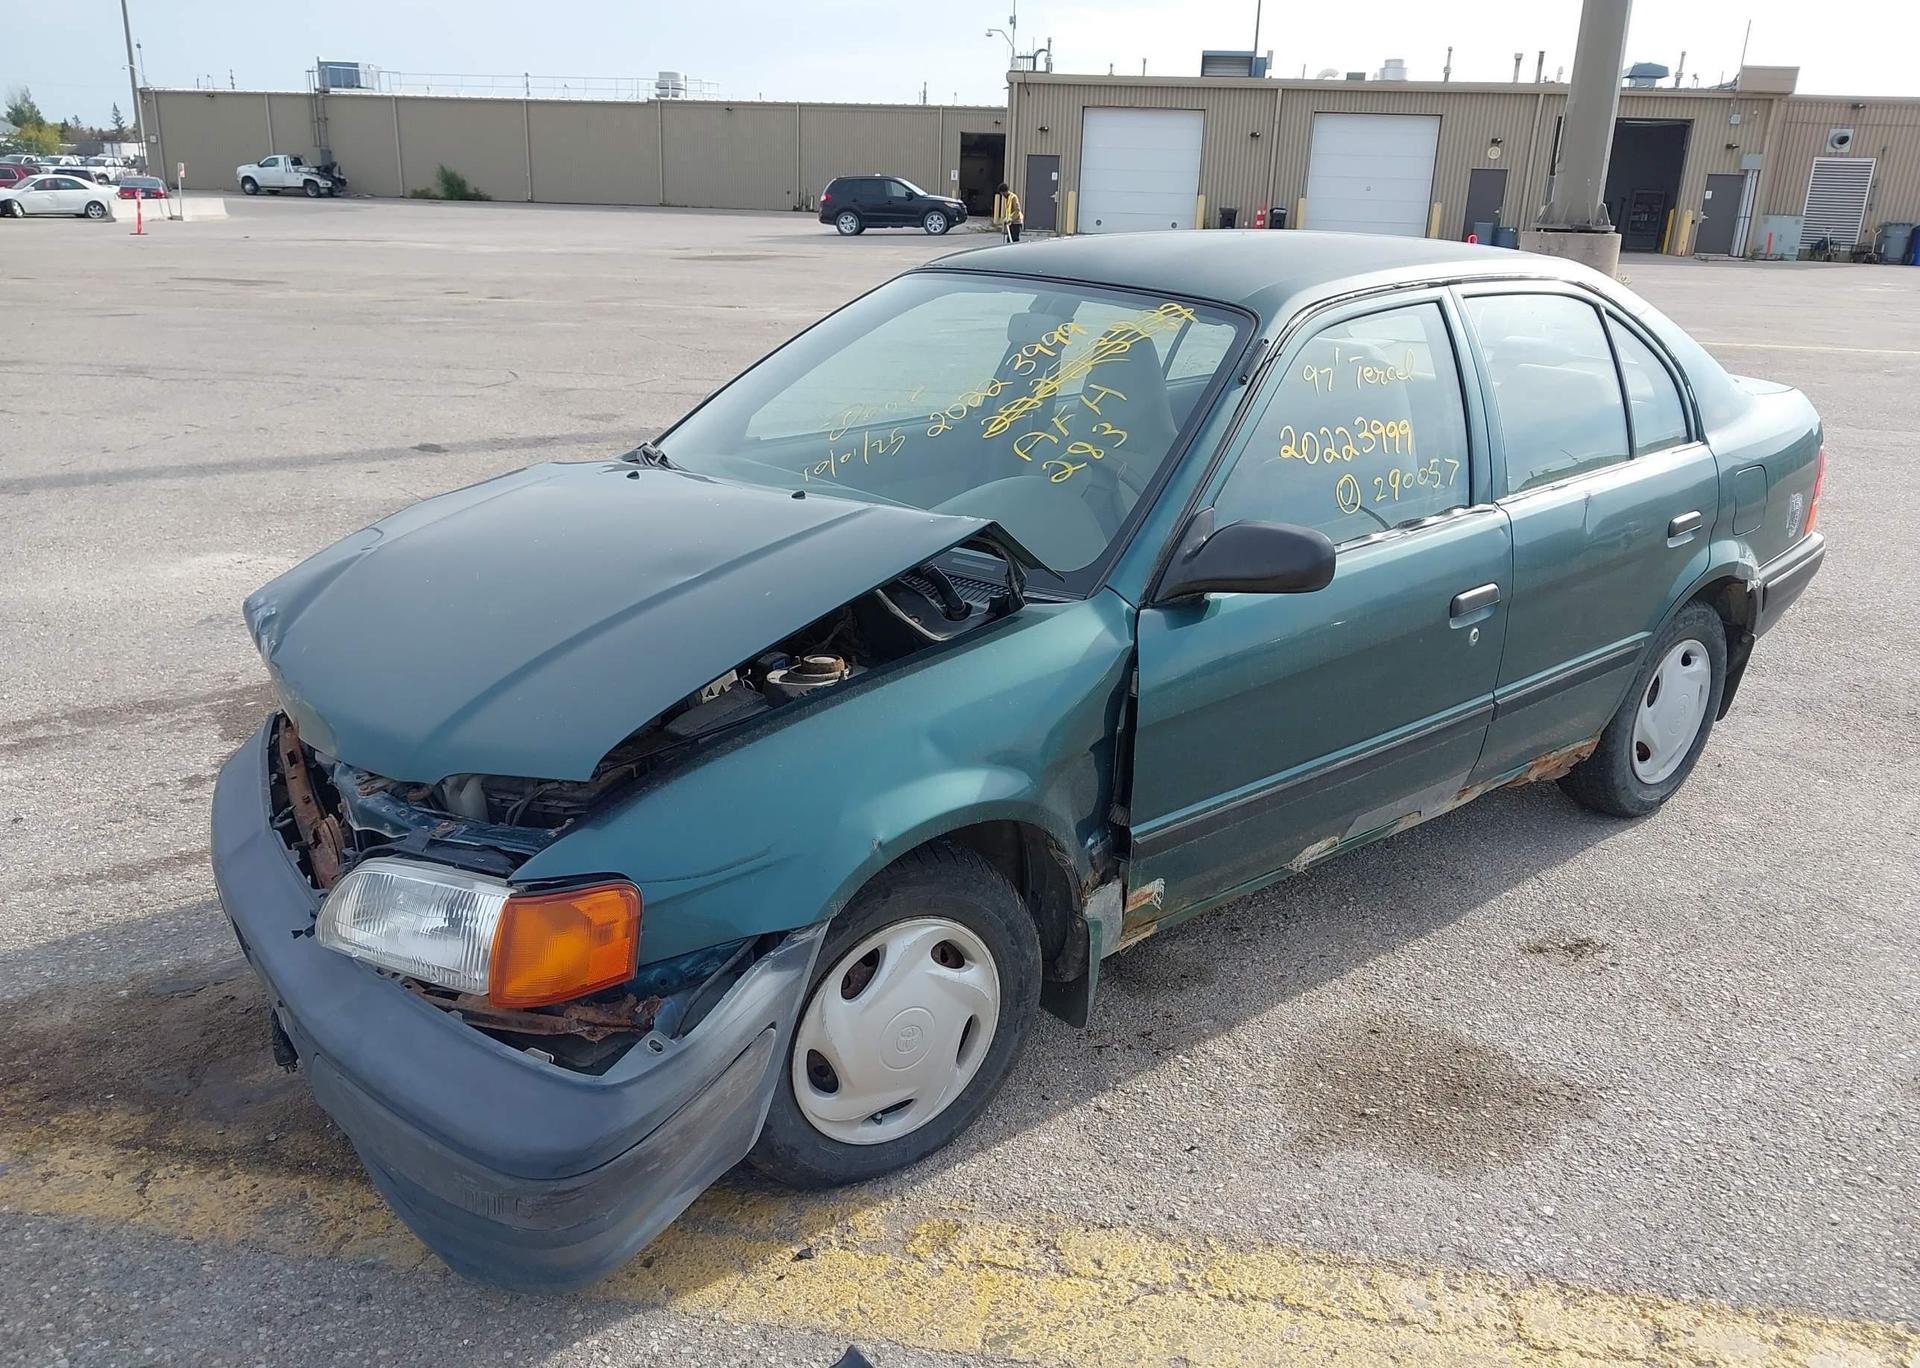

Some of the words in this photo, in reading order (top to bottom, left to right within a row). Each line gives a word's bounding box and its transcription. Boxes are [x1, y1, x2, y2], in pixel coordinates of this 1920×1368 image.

[1042, 422, 1128, 483] 283
[1279, 416, 1414, 465] 20223999
[1373, 457, 1460, 501] 290057
